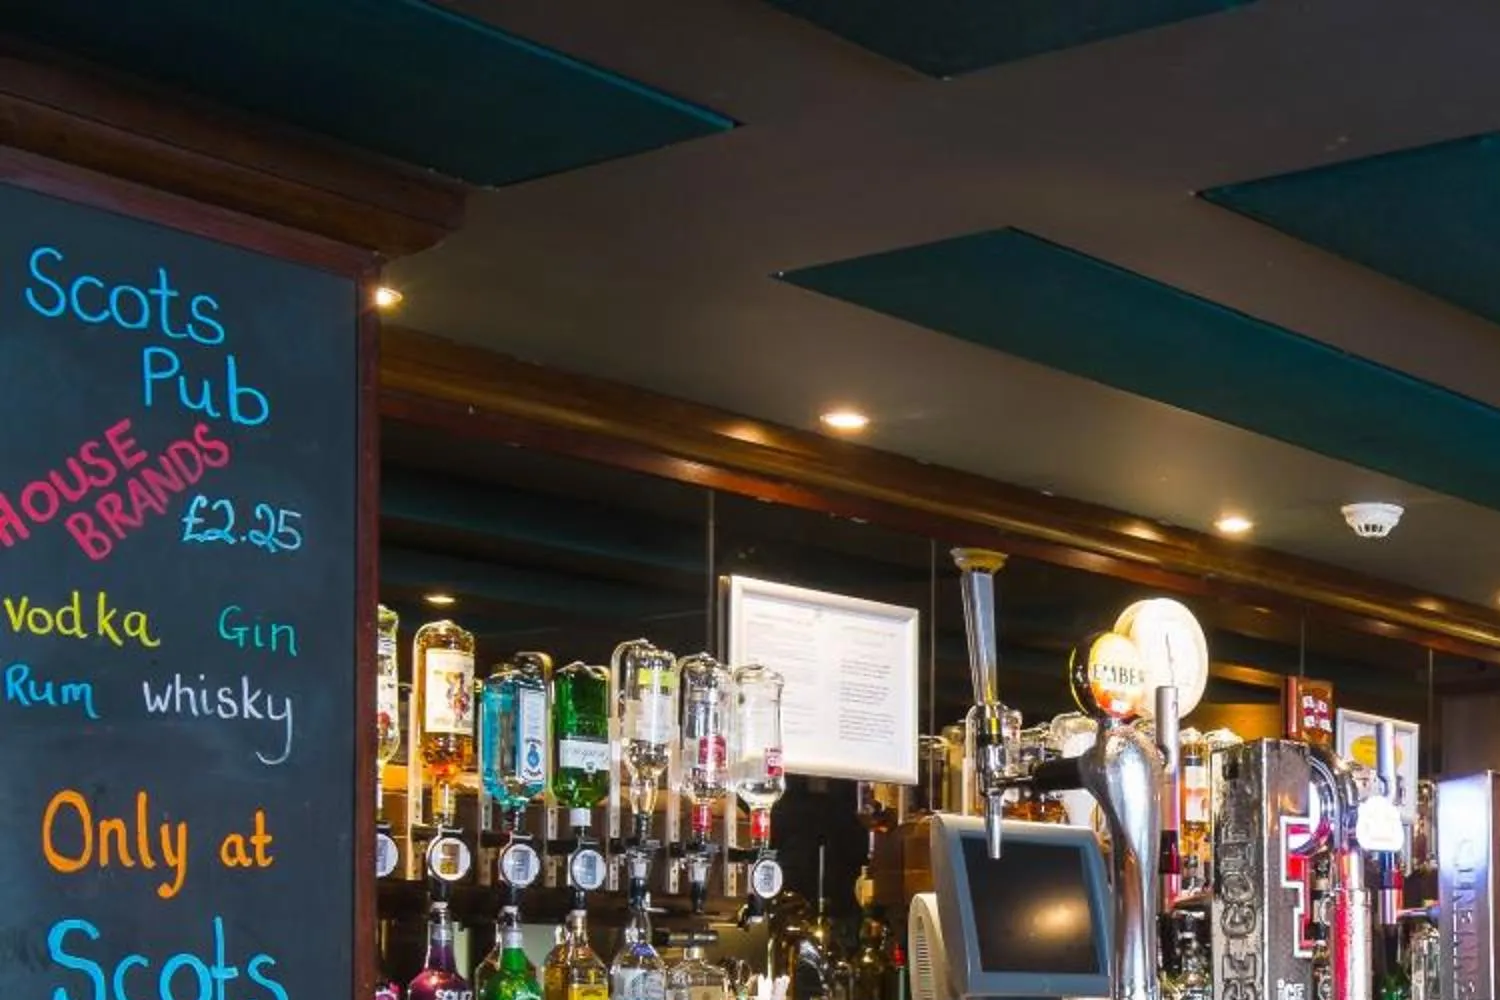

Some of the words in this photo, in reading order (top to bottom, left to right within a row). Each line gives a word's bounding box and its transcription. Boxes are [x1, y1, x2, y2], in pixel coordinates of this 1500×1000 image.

[25, 246, 226, 345] Scots
[142, 346, 270, 426] Pub
[0, 417, 150, 549] HOUSE
[63, 422, 231, 562] BRANDS
[180, 494, 303, 554] £2.25
[217, 604, 298, 658] Gin
[4, 663, 102, 720] Rum
[41, 788, 189, 899] Only
[218, 808, 275, 869] at
